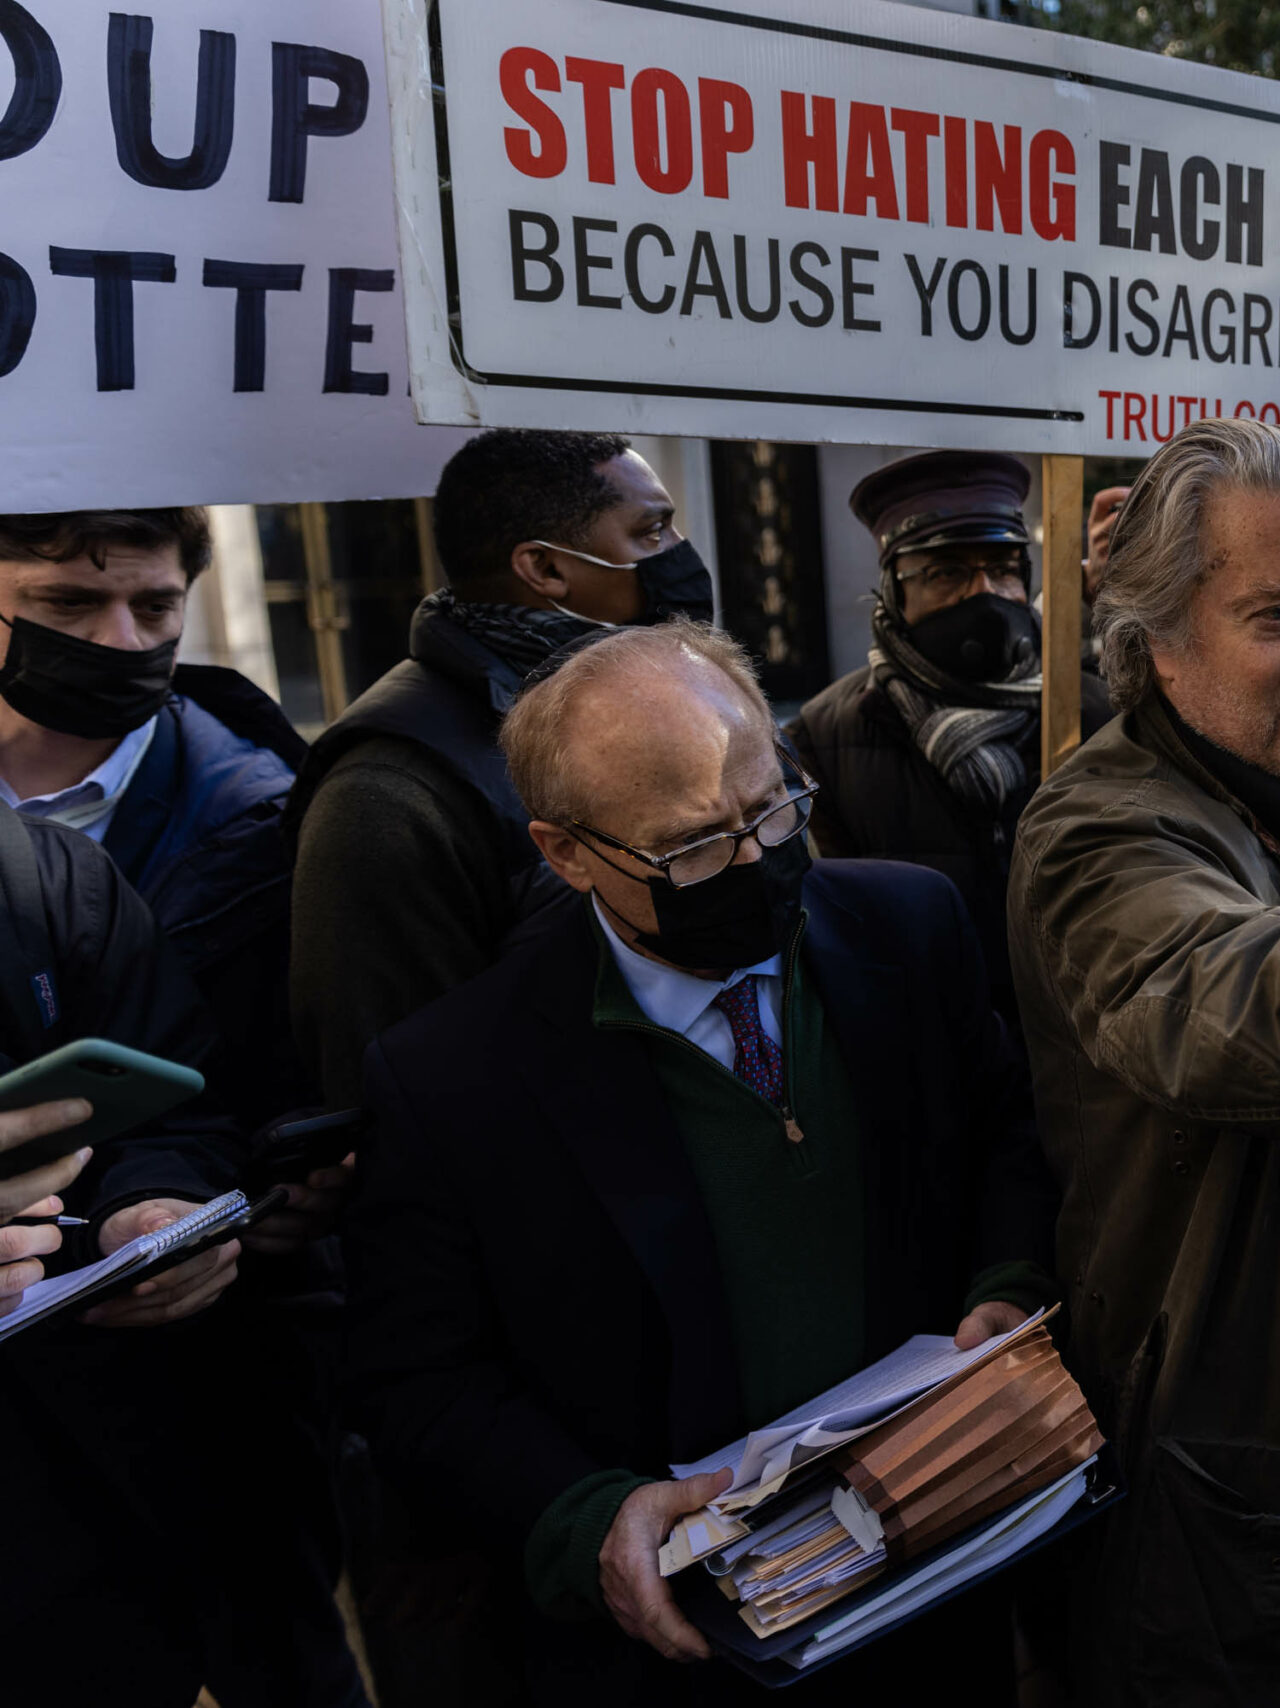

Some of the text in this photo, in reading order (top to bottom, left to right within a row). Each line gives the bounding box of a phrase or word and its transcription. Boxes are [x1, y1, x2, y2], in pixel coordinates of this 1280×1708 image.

[500, 46, 754, 199] STOP
[781, 90, 1076, 242] HATING
[1100, 140, 1264, 266] EACH
[509, 209, 881, 332] BECAUSE
[904, 254, 1036, 345] YOU
